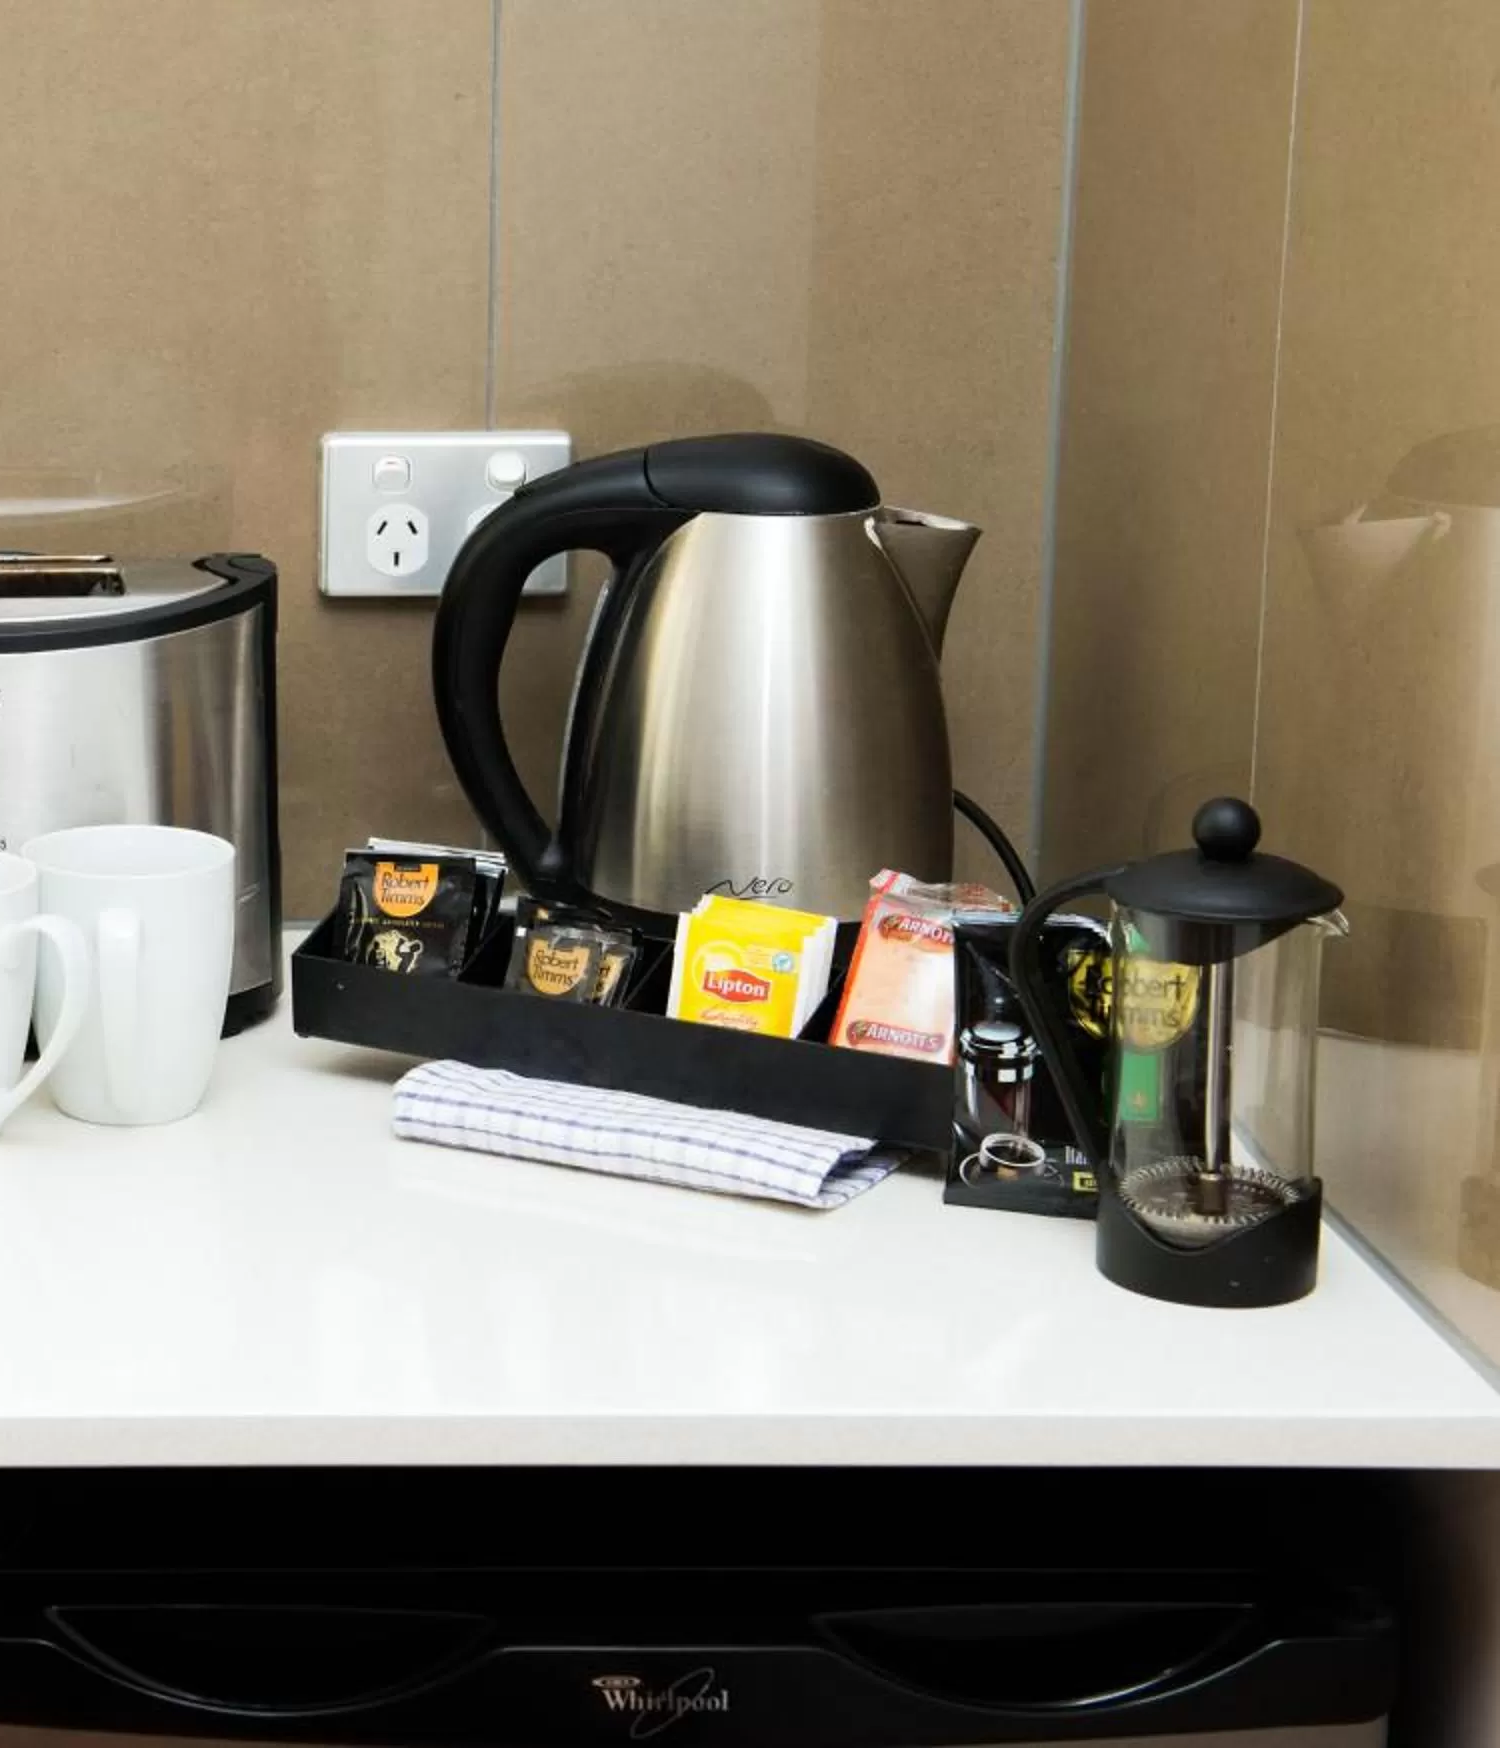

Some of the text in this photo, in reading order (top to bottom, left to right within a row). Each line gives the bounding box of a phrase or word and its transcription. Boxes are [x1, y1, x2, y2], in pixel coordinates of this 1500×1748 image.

[381, 871, 430, 890] Robert
[705, 876, 794, 897] Nero
[534, 949, 579, 971] Robert
[707, 968, 767, 998] Lipton
[601, 1688, 730, 1717] Whirlpool
